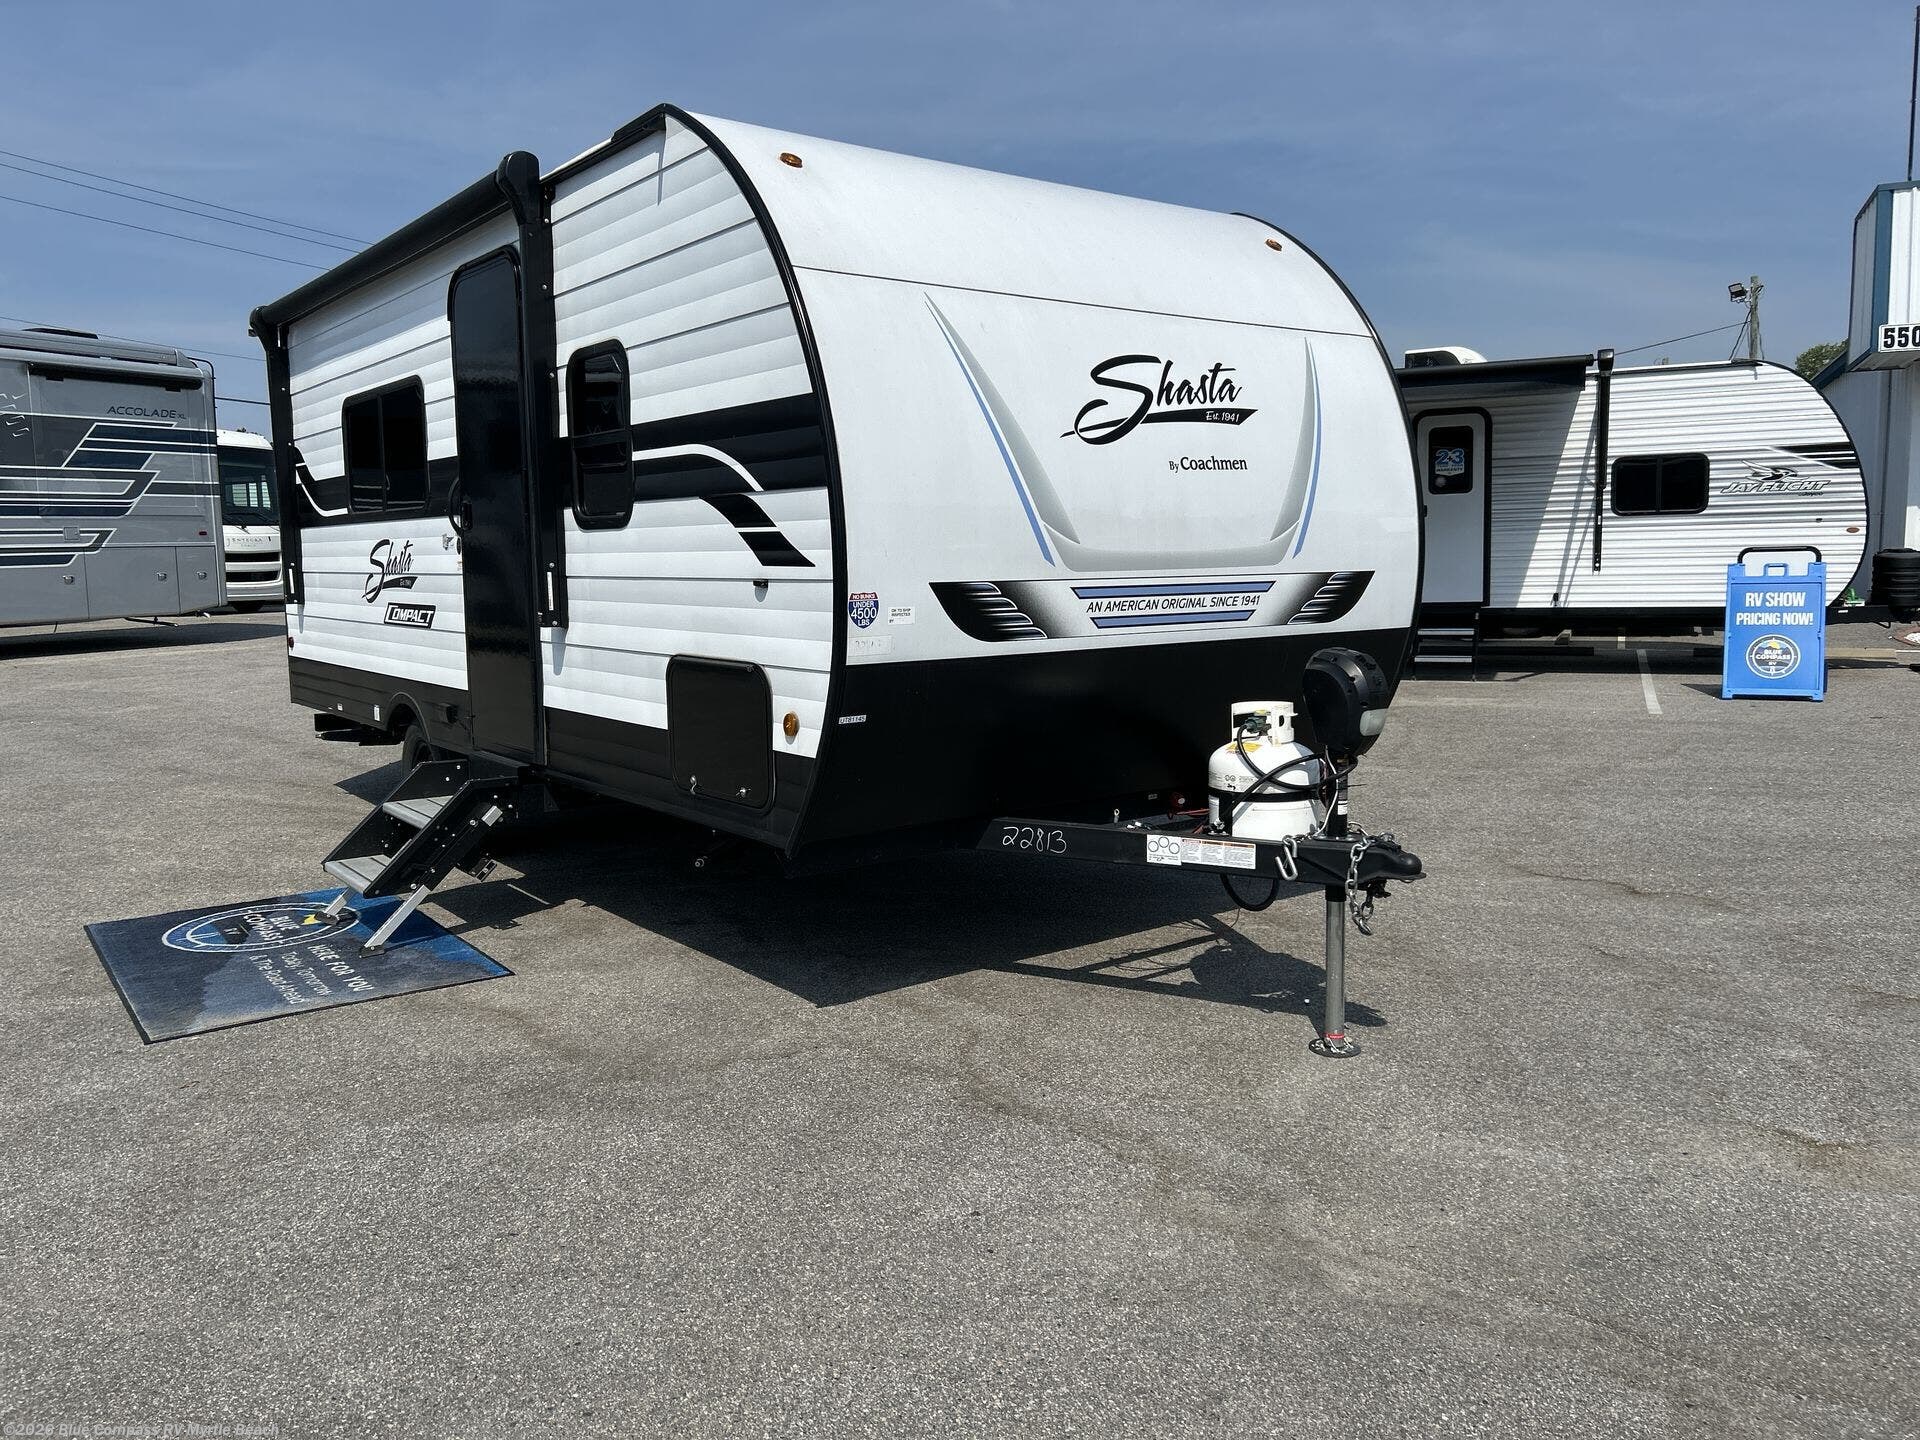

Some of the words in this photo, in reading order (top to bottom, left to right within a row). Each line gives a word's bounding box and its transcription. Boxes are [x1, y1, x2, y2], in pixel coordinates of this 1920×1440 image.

[1074, 354, 1243, 445] Shasta
[107, 405, 177, 418] ACCOLADE
[1221, 412, 1240, 423] 1941
[1168, 461, 1179, 473] By
[1180, 456, 1248, 471] Coachmen
[1720, 481, 1759, 494] JAY
[1757, 479, 1832, 493] FLIGHT
[364, 538, 415, 604] Shasta
[852, 600, 875, 608] UNDER
[1086, 601, 1103, 613] AN
[1104, 599, 1160, 612] AMERICAN
[1161, 597, 1208, 609] ORIGINAL
[1209, 596, 1238, 607] SINCE
[1241, 595, 1261, 606] 1941
[1745, 592, 1764, 607] RV
[1765, 592, 1806, 607] SHOW
[386, 605, 434, 627] COMPACT
[851, 607, 877, 619] 4500
[1736, 612, 1780, 626] PRICING
[1782, 612, 1814, 626] NOW!
[857, 618, 870, 626] LBS
[1002, 826, 1067, 854] 22813
[243, 913, 284, 942] COMPASS
[269, 915, 301, 931] BLUE
[306, 944, 341, 961] HERE
[325, 960, 356, 977] FOR
[343, 975, 375, 992] YOU
[297, 967, 333, 996] Tomorrow
